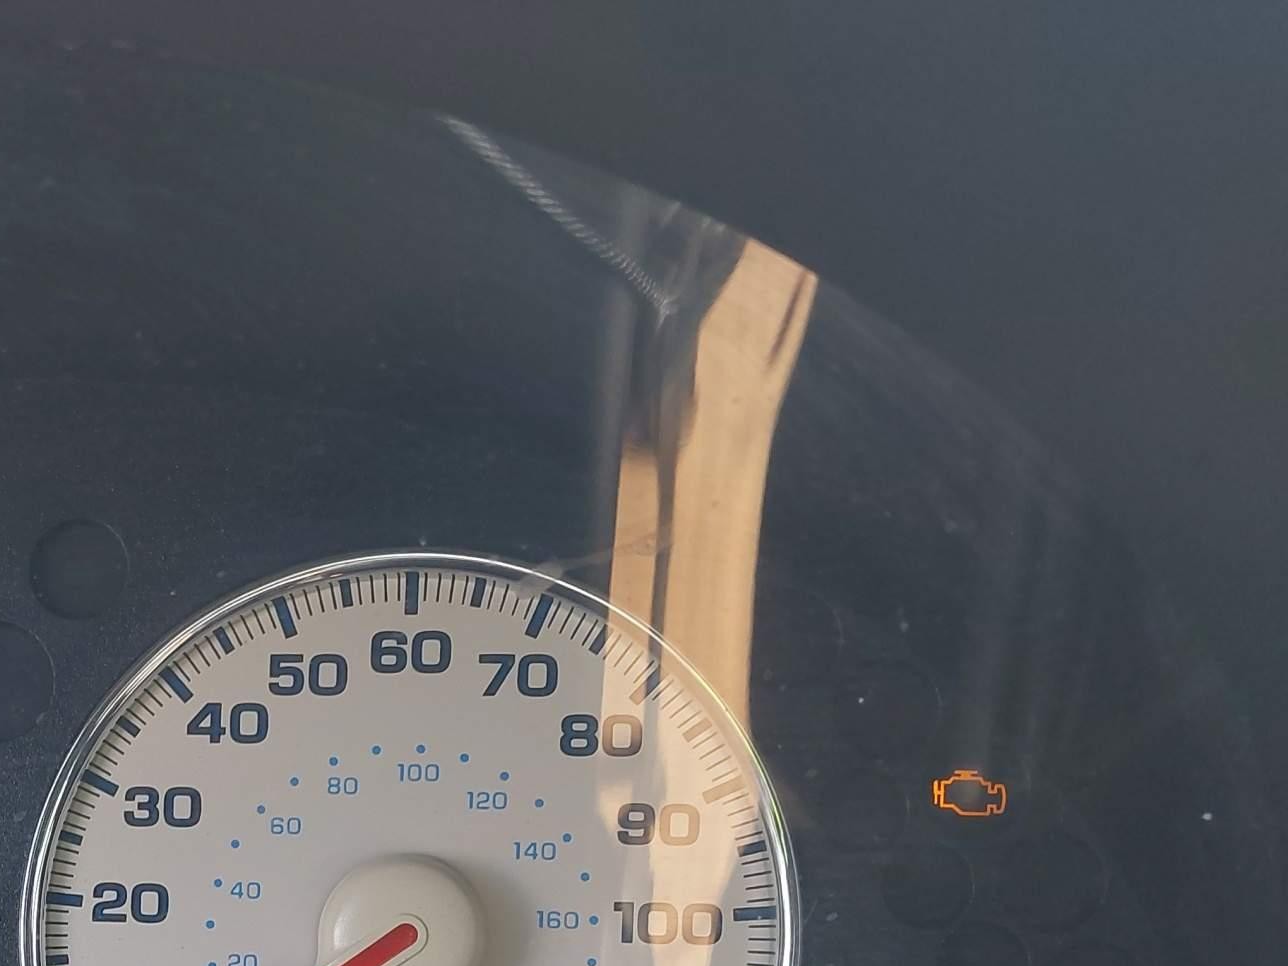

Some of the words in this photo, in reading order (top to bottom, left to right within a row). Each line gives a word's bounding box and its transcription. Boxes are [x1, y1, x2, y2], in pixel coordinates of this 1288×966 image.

[370, 630, 452, 674] 60
[268, 653, 348, 696] 50
[477, 652, 560, 698] 70
[185, 702, 271, 745] 40
[557, 713, 644, 758] 80
[327, 776, 358, 795] 80
[397, 764, 440, 783] 100
[121, 786, 203, 829] 30
[466, 791, 509, 811] 120
[269, 816, 302, 836] 60
[615, 802, 702, 847] 90
[514, 842, 557, 861] 140
[91, 883, 170, 923] 20
[229, 880, 262, 900] 40
[535, 911, 579, 930] 160
[613, 900, 724, 946] 100
